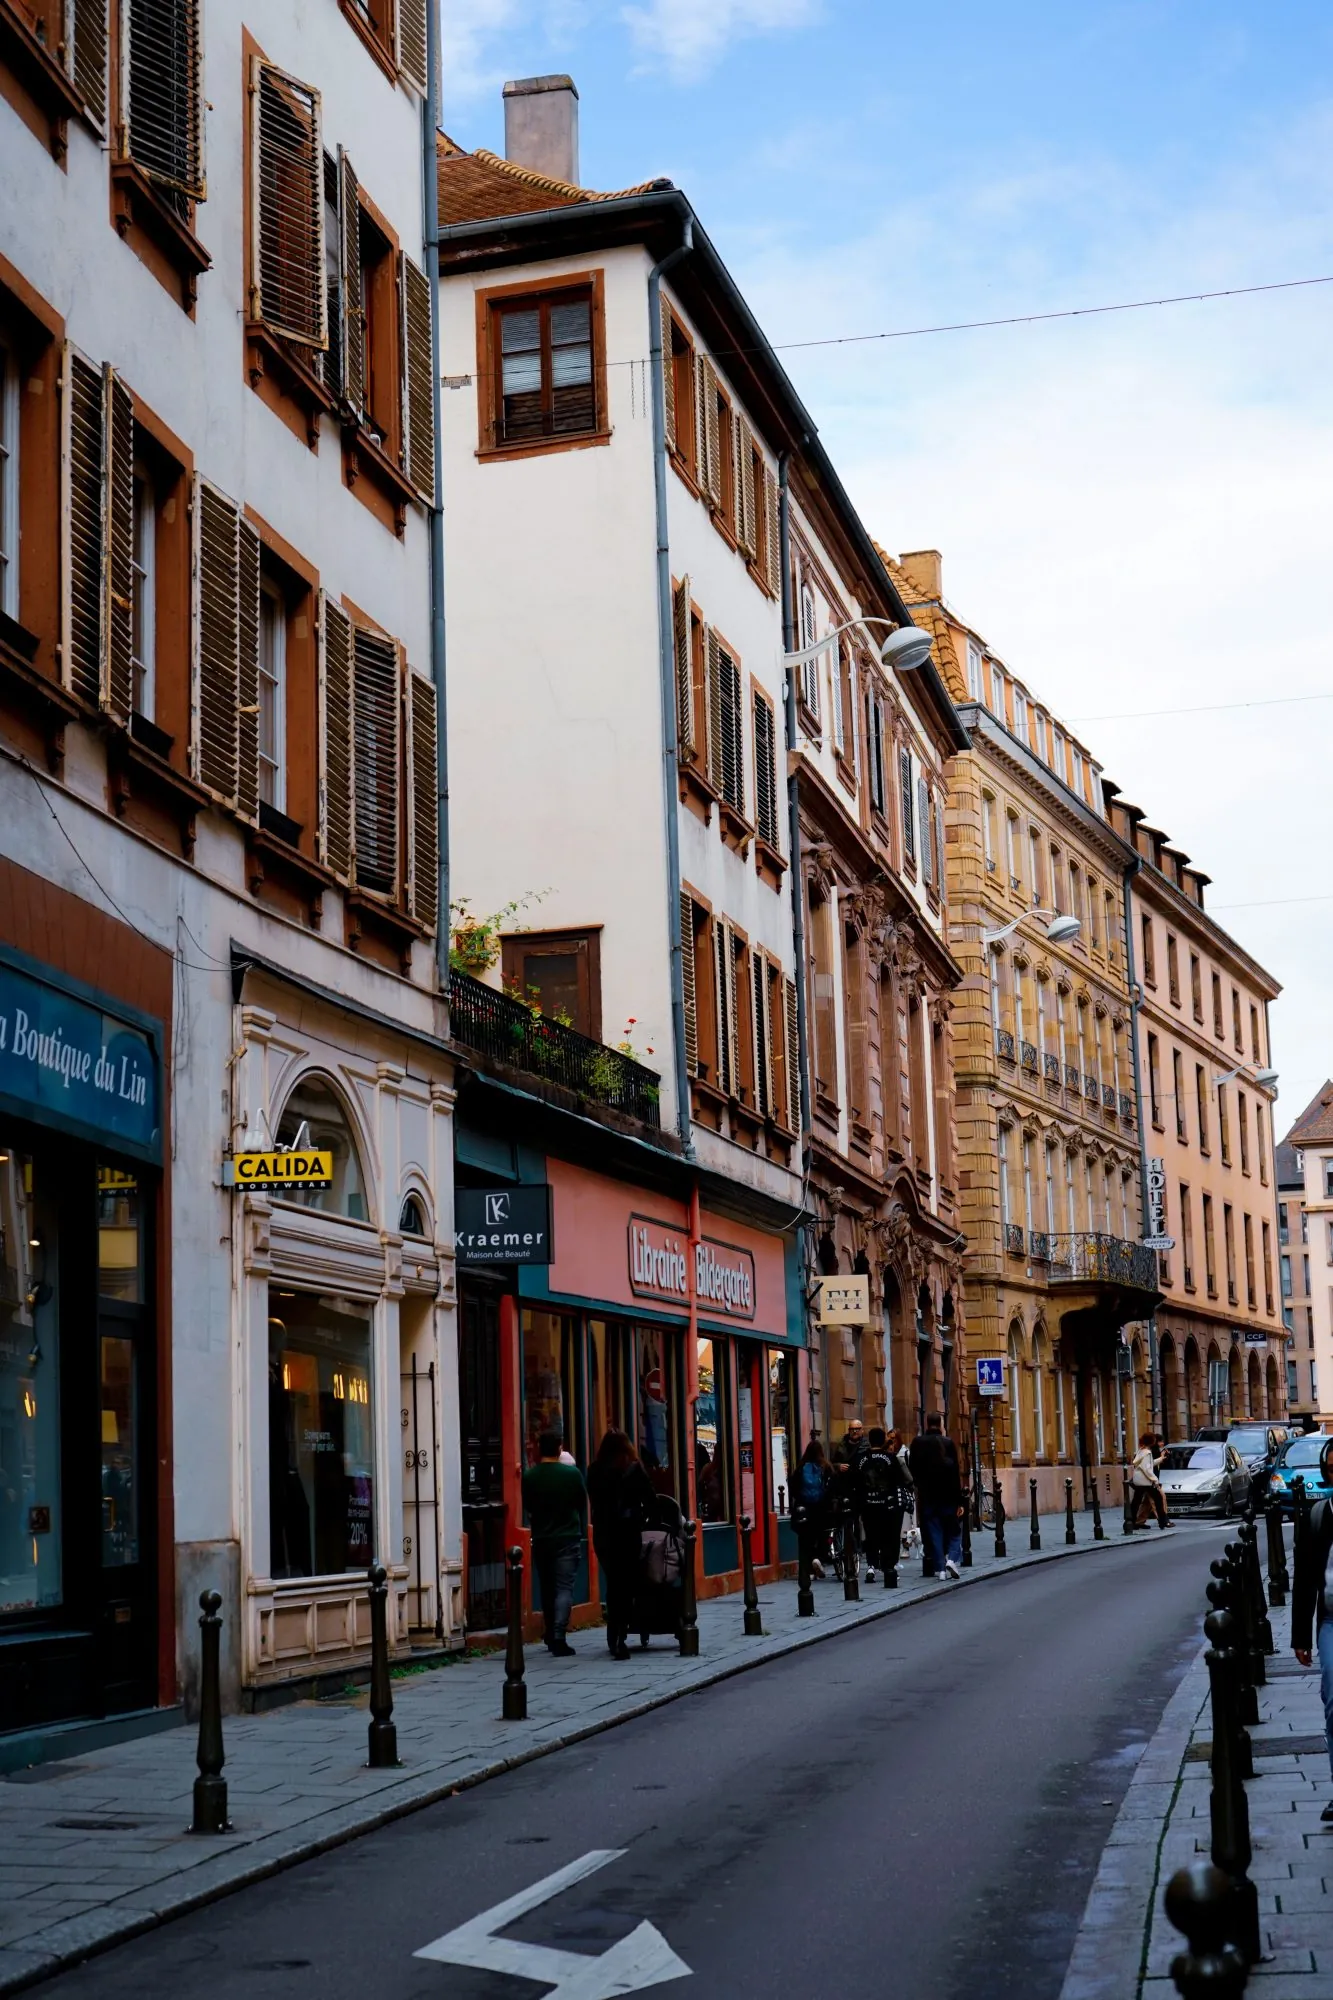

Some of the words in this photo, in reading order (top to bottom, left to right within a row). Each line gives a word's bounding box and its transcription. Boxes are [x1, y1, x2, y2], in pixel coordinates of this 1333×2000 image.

[12, 1008, 91, 1088] Boutique
[94, 1046, 115, 1093] du
[118, 1055, 146, 1106] Lin
[238, 1157, 325, 1178] CALIDA
[238, 1181, 326, 1190] BODYWEAR
[1146, 1158, 1166, 1237] HOTEL
[455, 1231, 543, 1247] Kraemer
[466, 1251, 493, 1259] Maison
[494, 1250, 504, 1258] de
[505, 1248, 531, 1258] Beauté
[632, 1226, 686, 1292] Librairie
[696, 1245, 751, 1311] Bildergarte
